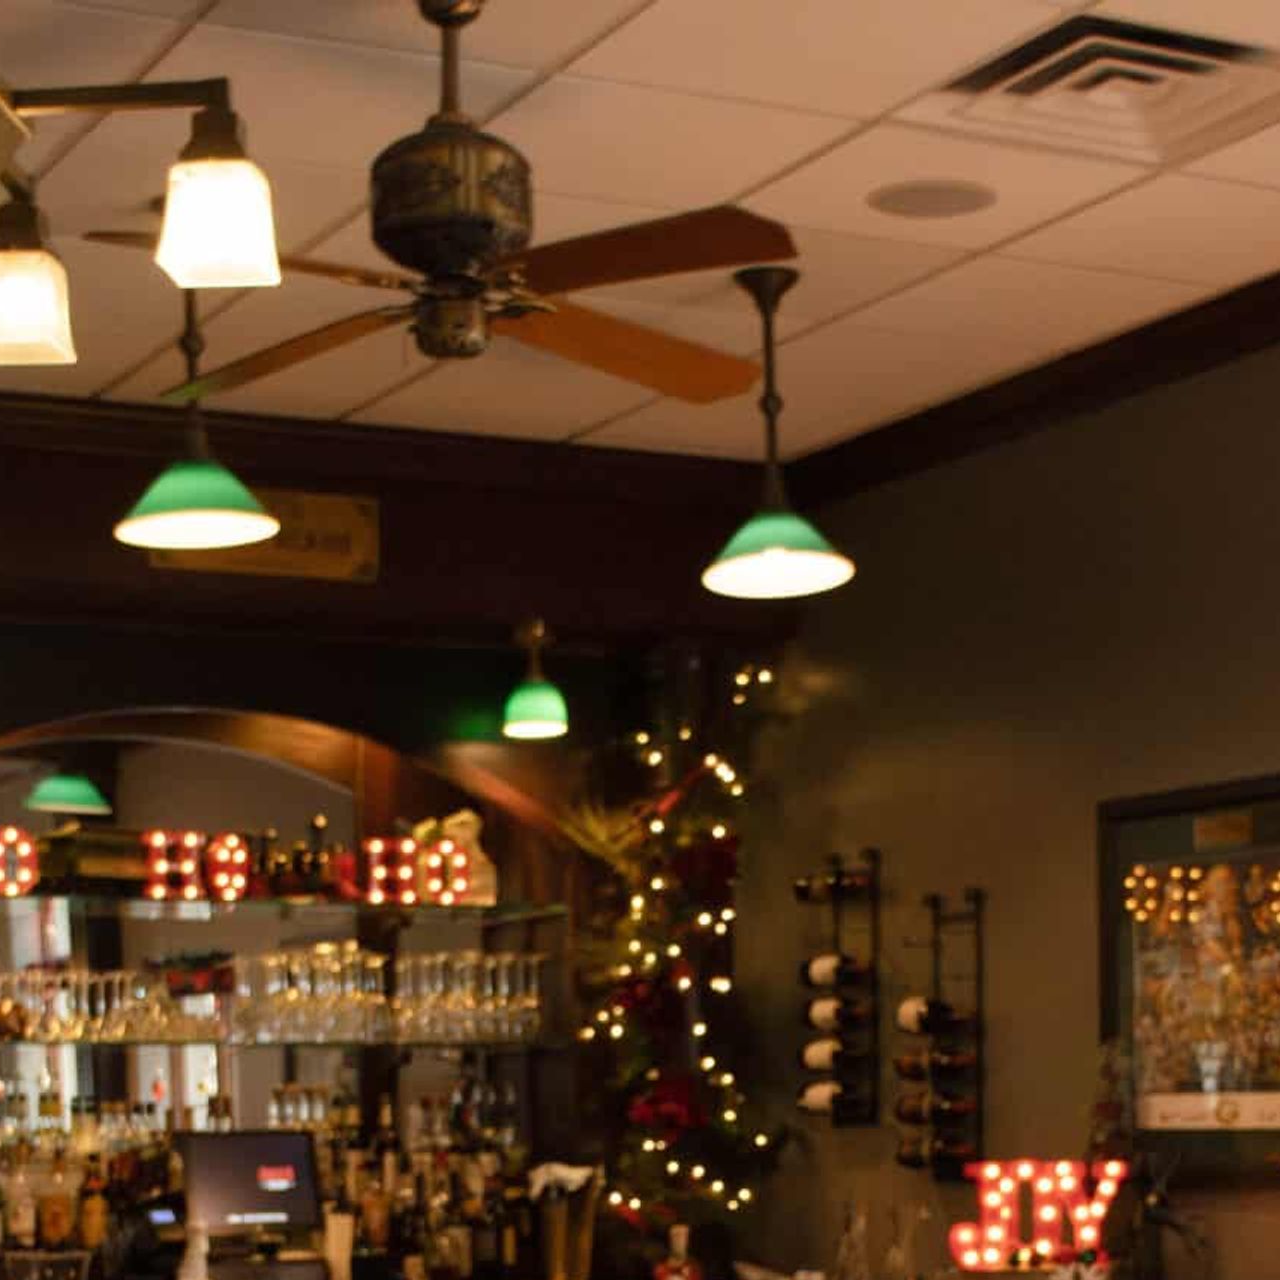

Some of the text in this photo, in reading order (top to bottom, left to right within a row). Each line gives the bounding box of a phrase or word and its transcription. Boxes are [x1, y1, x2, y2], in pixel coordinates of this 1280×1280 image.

[145, 830, 250, 901] HO
[363, 837, 471, 906] HO
[949, 1160, 1128, 1272] JOY
